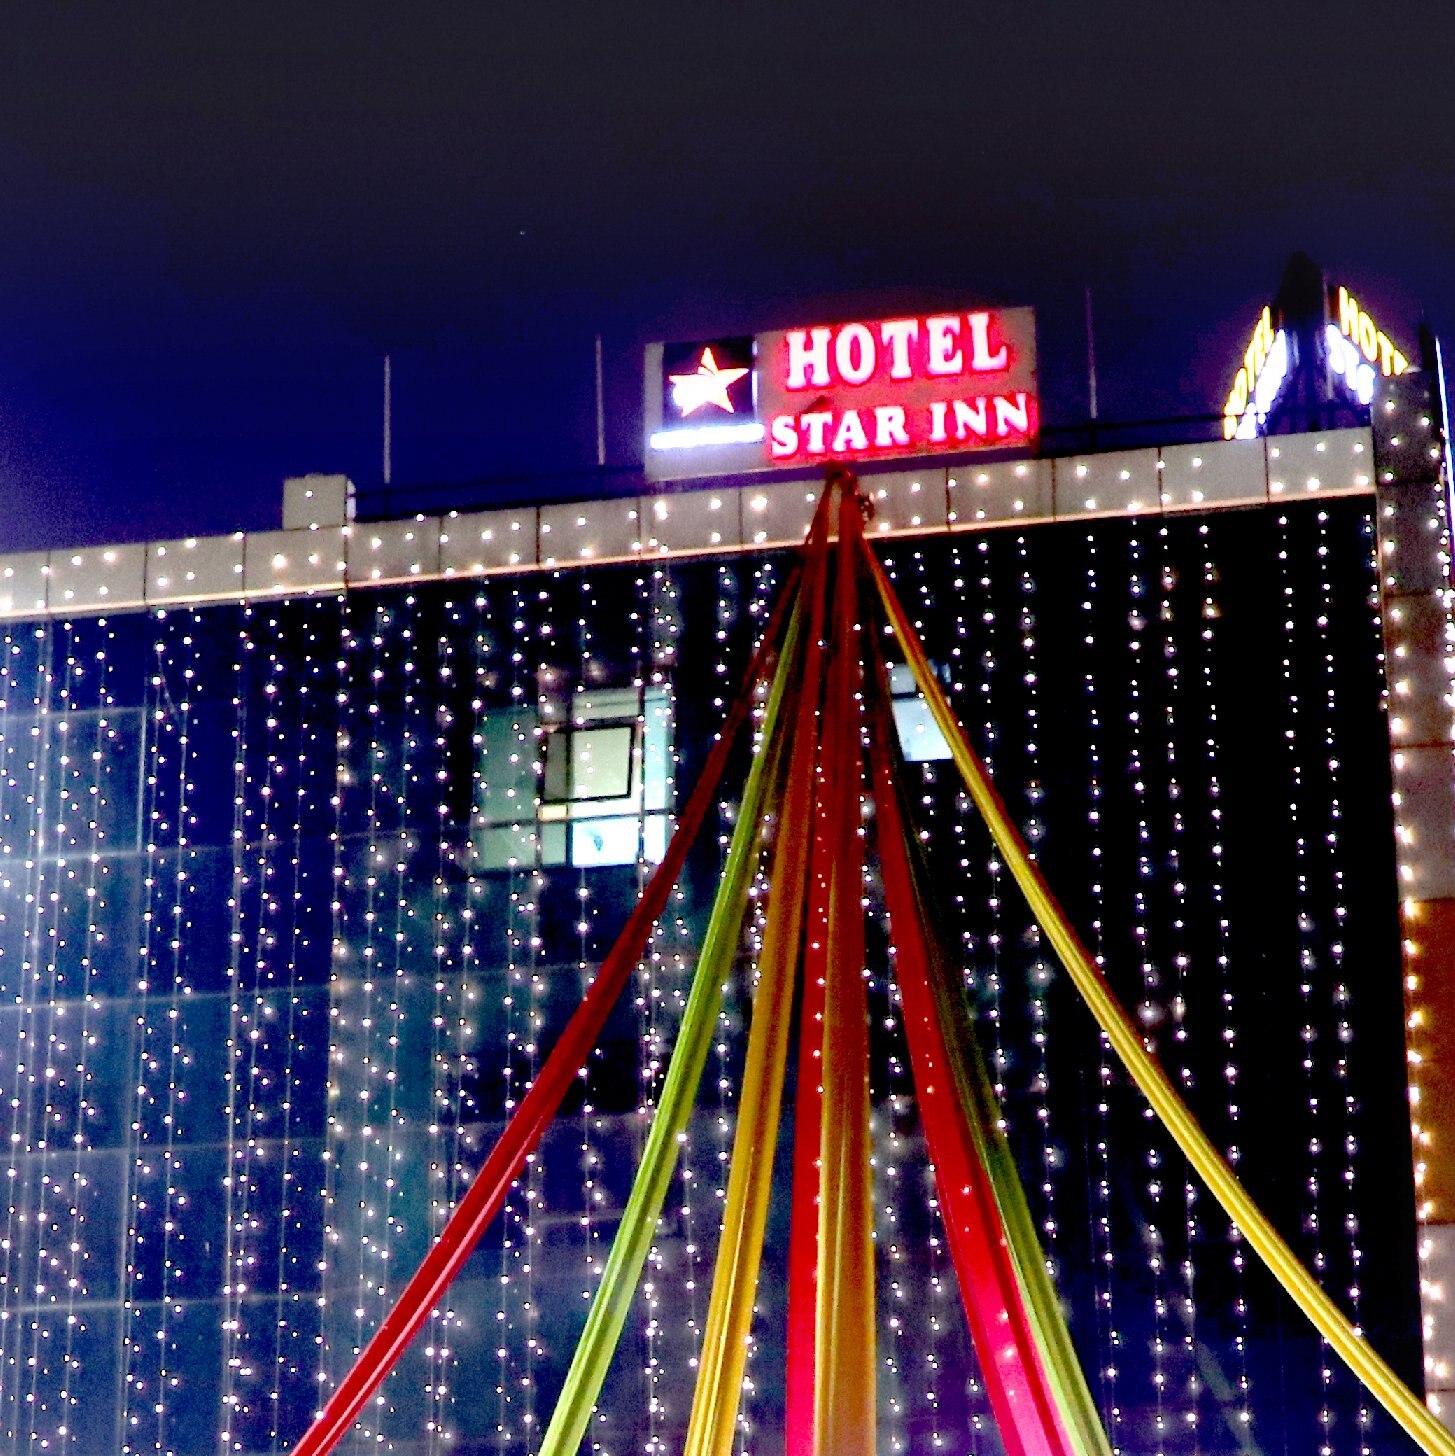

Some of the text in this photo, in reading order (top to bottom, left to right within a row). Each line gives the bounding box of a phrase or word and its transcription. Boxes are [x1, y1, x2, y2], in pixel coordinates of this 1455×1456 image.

[785, 312, 1008, 391] HOTEL
[771, 392, 1029, 458] STAR INN
